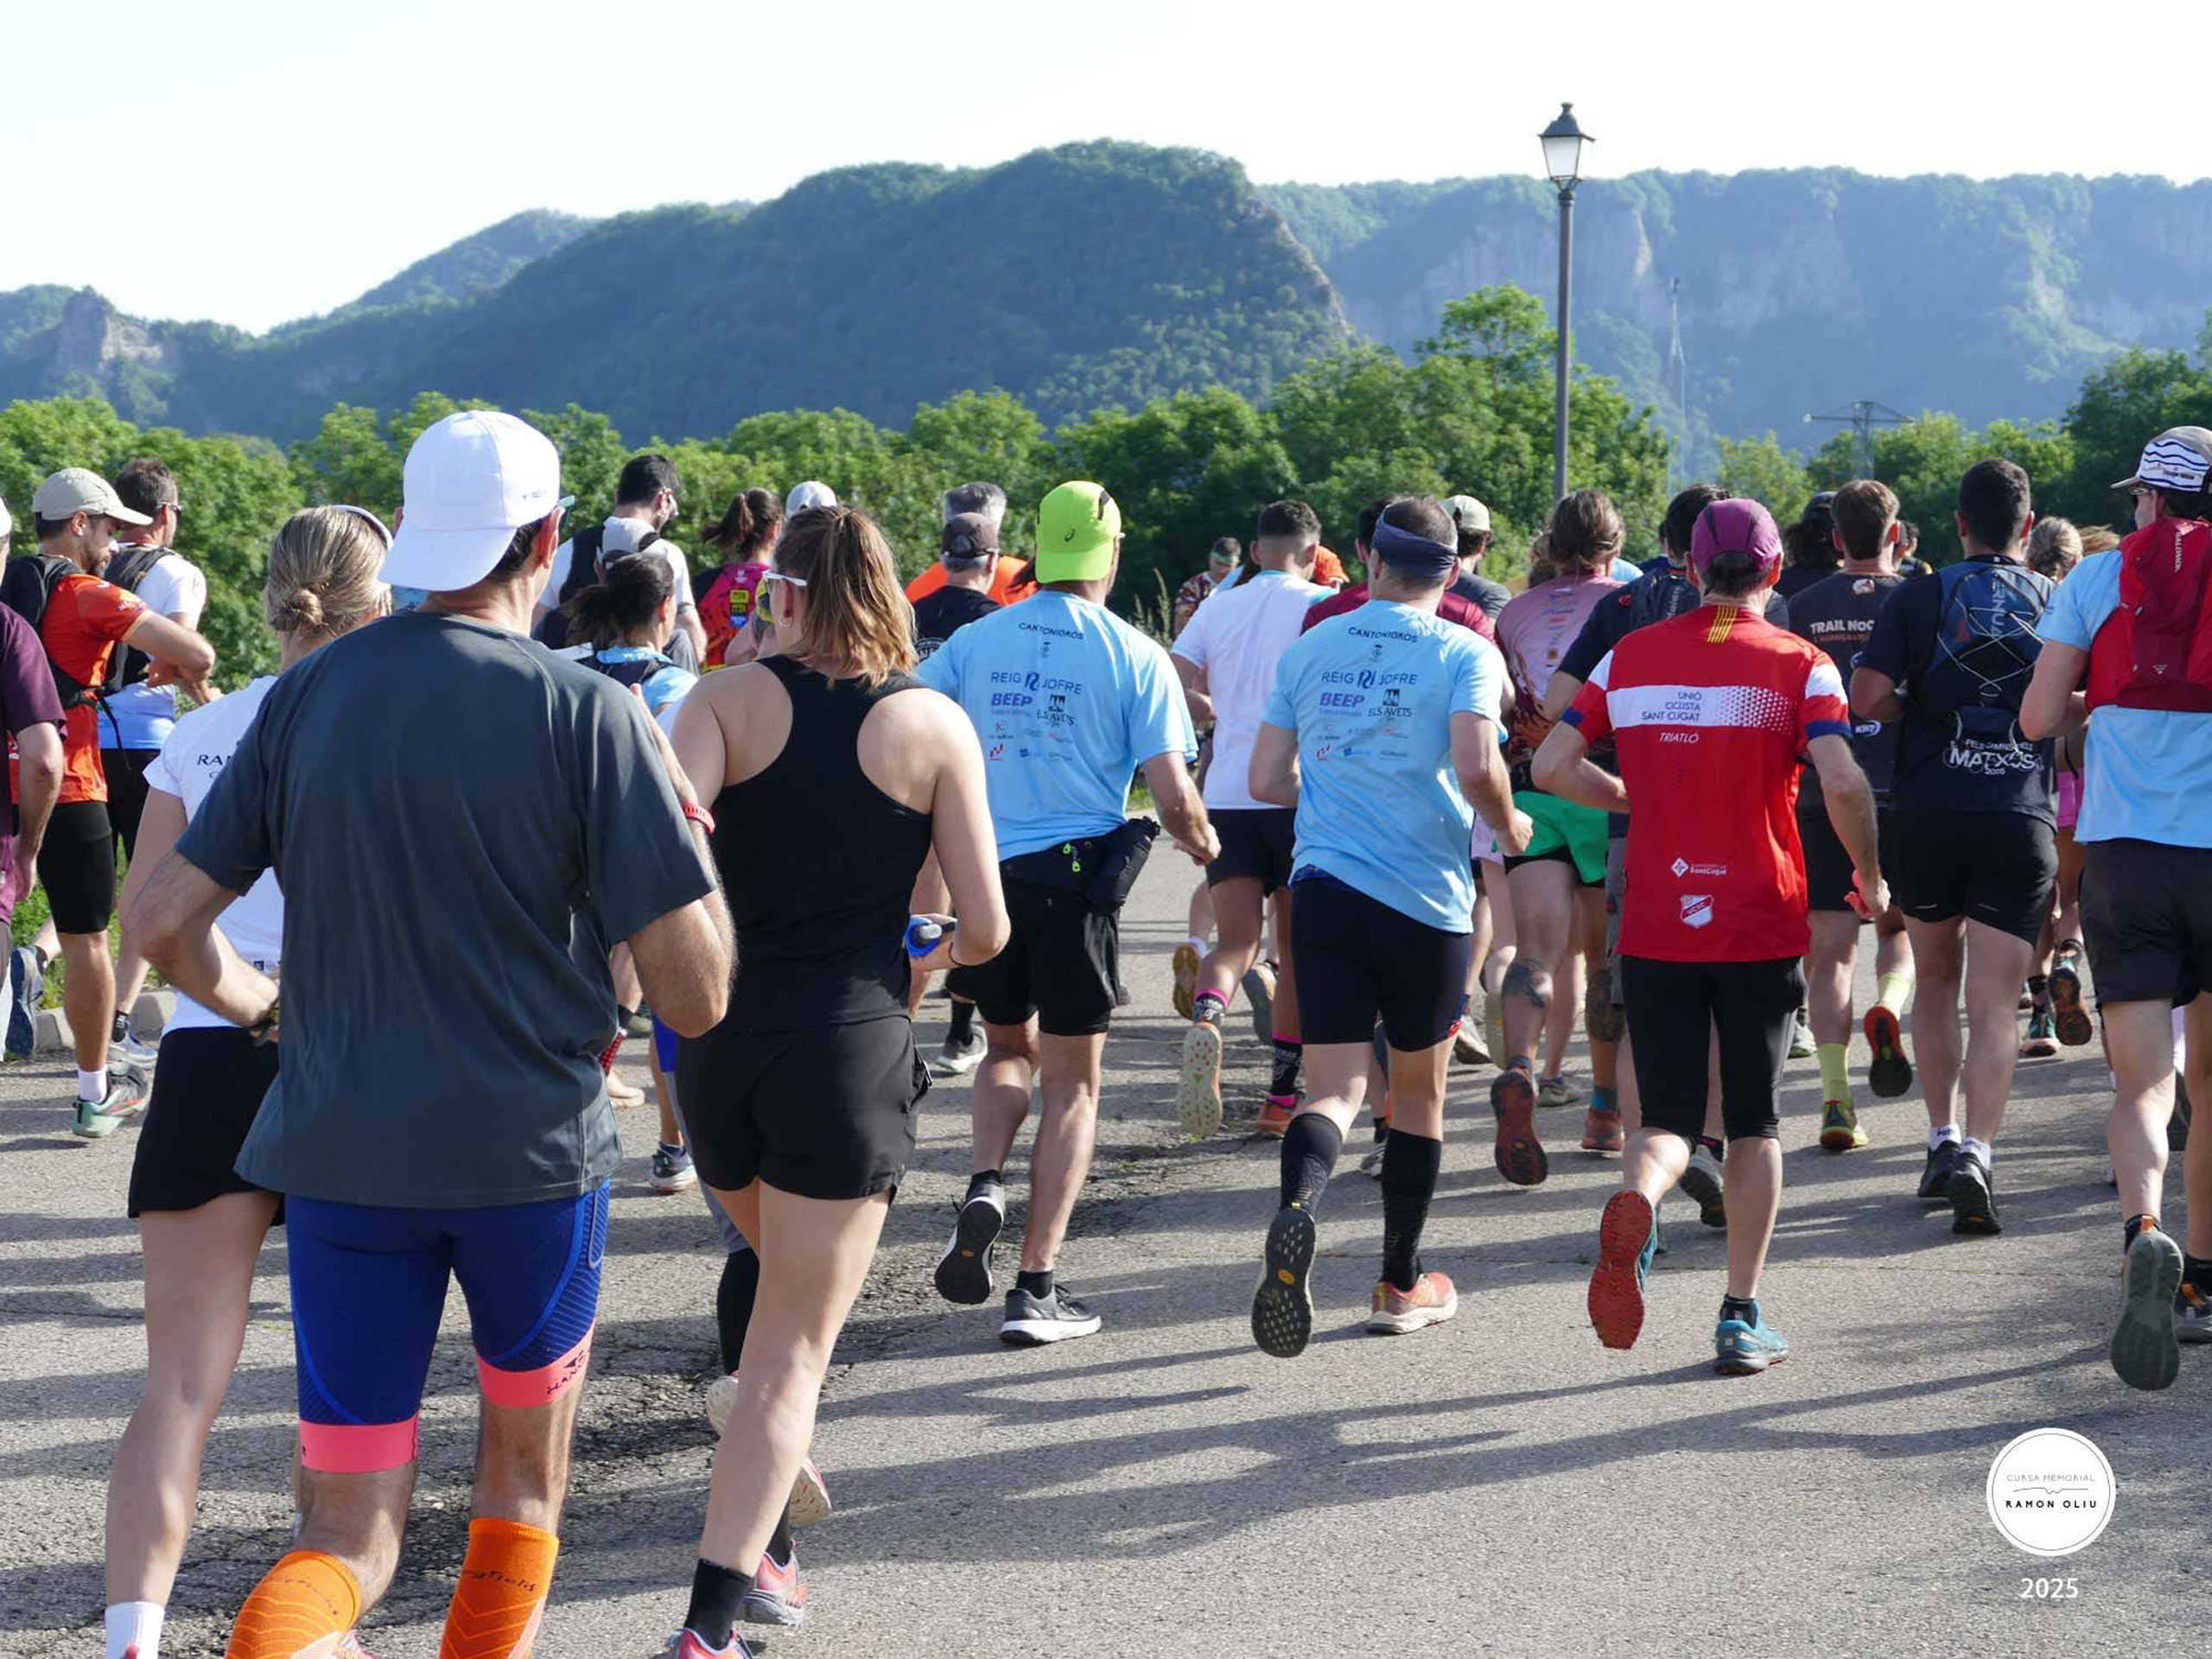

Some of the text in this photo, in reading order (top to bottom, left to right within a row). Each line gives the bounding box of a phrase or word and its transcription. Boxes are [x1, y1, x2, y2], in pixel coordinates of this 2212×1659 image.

[1810, 620, 1846, 633] TRAIL
[991, 672, 1083, 695] REIG JOFRE
[1321, 671, 1419, 685] REIG JOFRE
[991, 693, 1033, 707] BEEP
[1319, 692, 1365, 708] BEEP
[1383, 707, 1413, 717] AVETS
[1642, 711, 1700, 721] SANT CUGAT
[1659, 731, 1700, 743] TRIATLÓ
